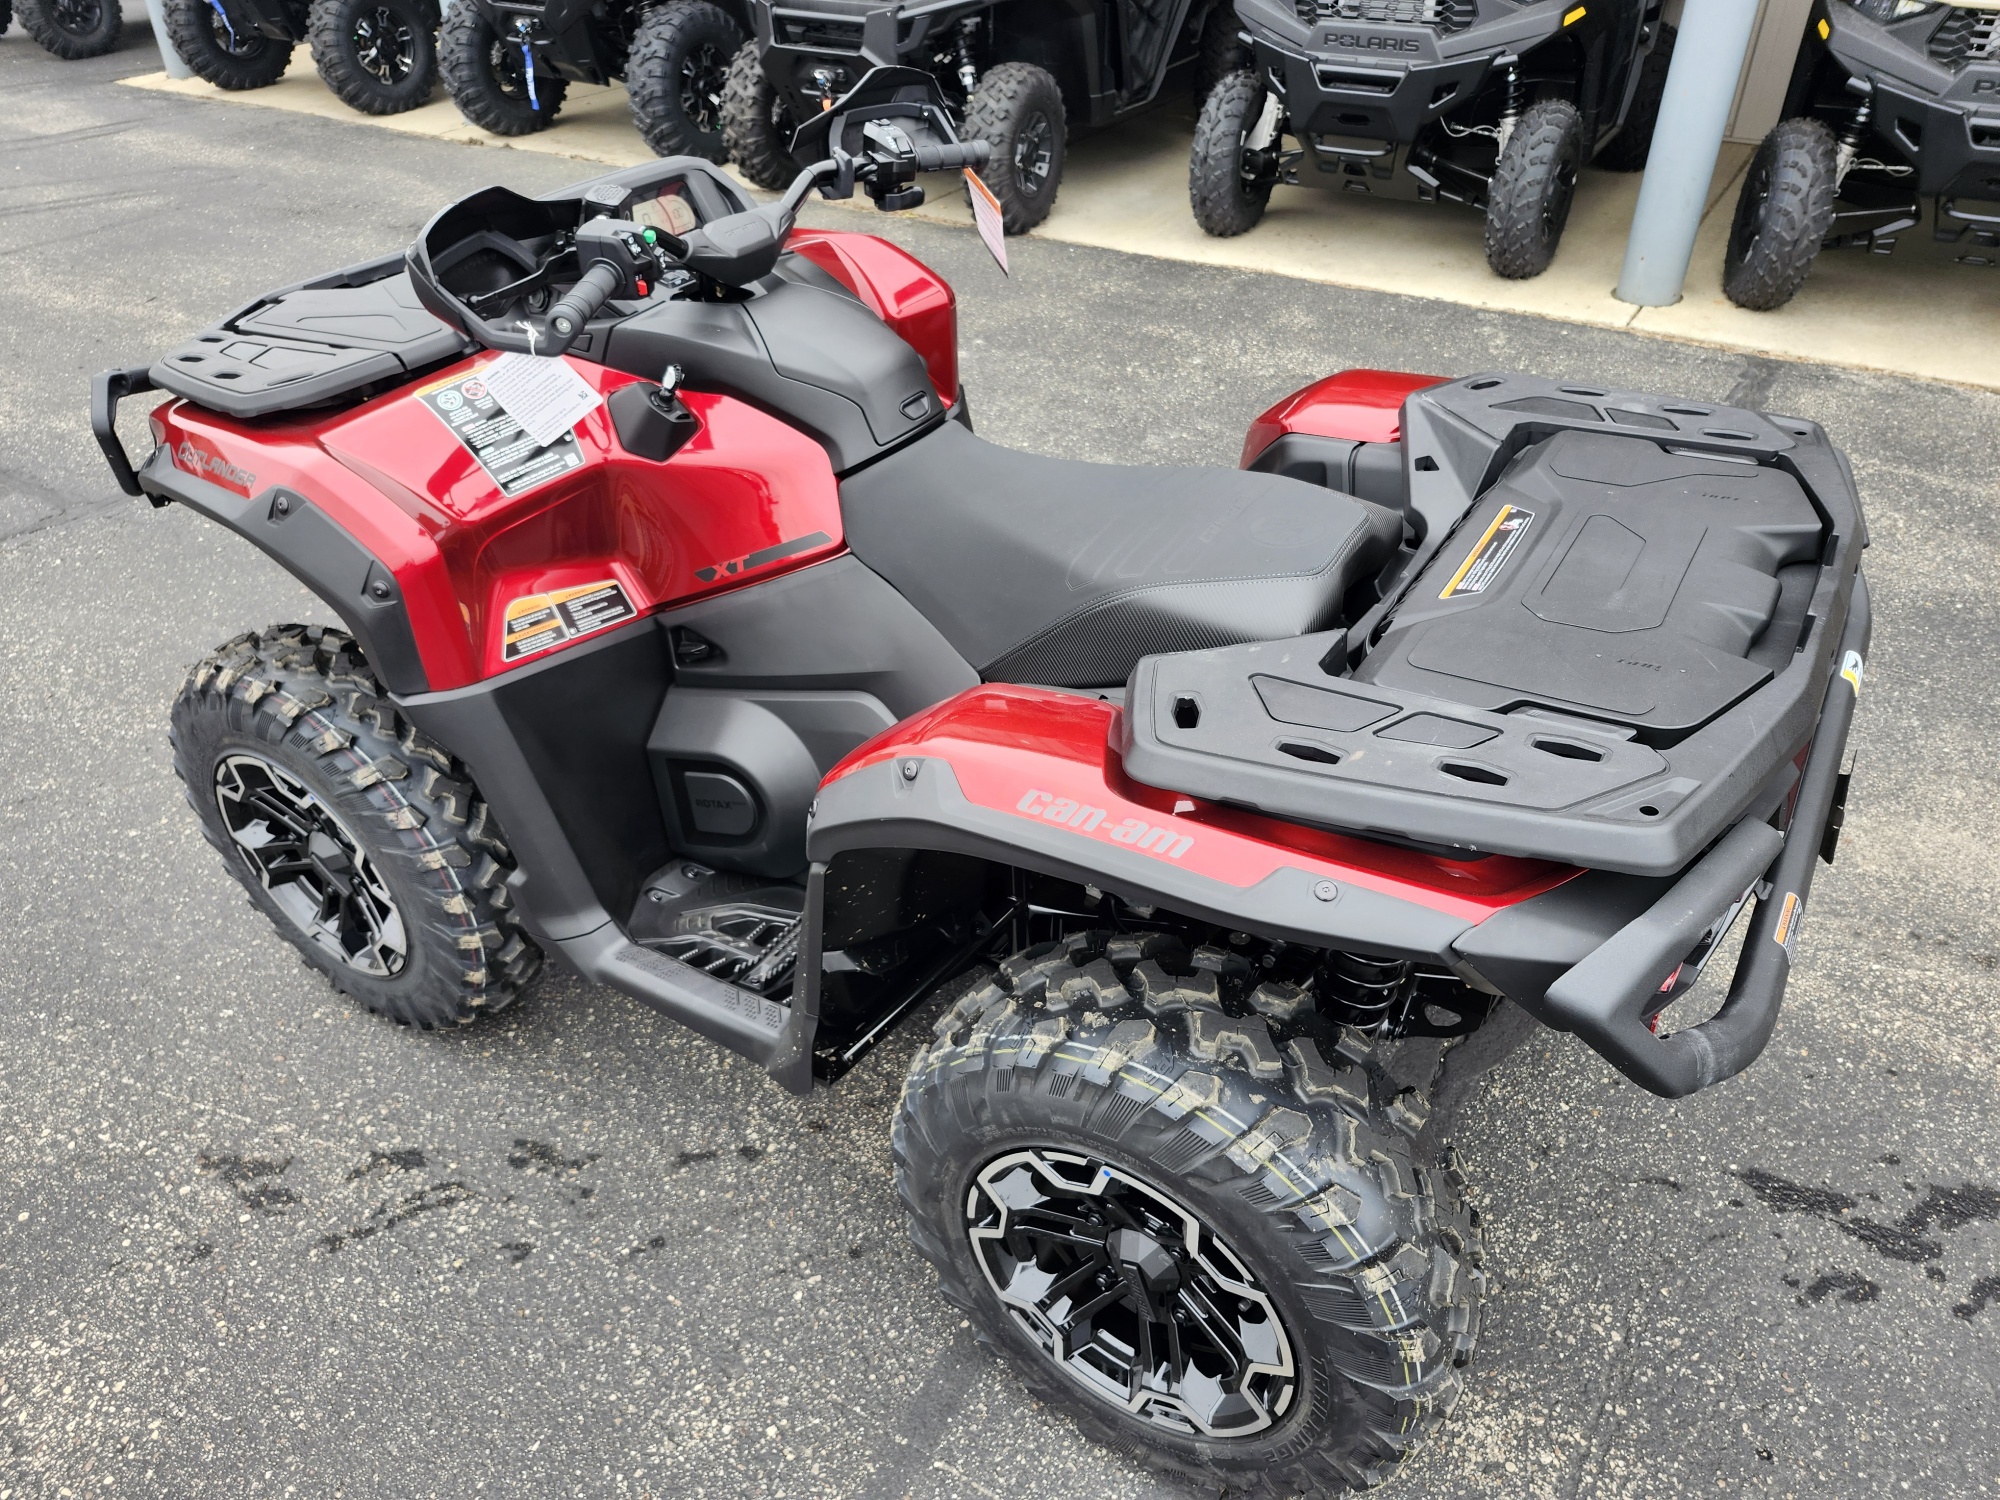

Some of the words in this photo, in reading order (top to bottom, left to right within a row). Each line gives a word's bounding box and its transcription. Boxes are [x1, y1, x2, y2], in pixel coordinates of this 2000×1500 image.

[1323, 33, 1420, 53] POLARIS
[179, 441, 257, 489] OUTLANDER
[712, 555, 752, 581] XT
[695, 798, 732, 809] ROTAX
[1016, 788, 1195, 859] can-am
